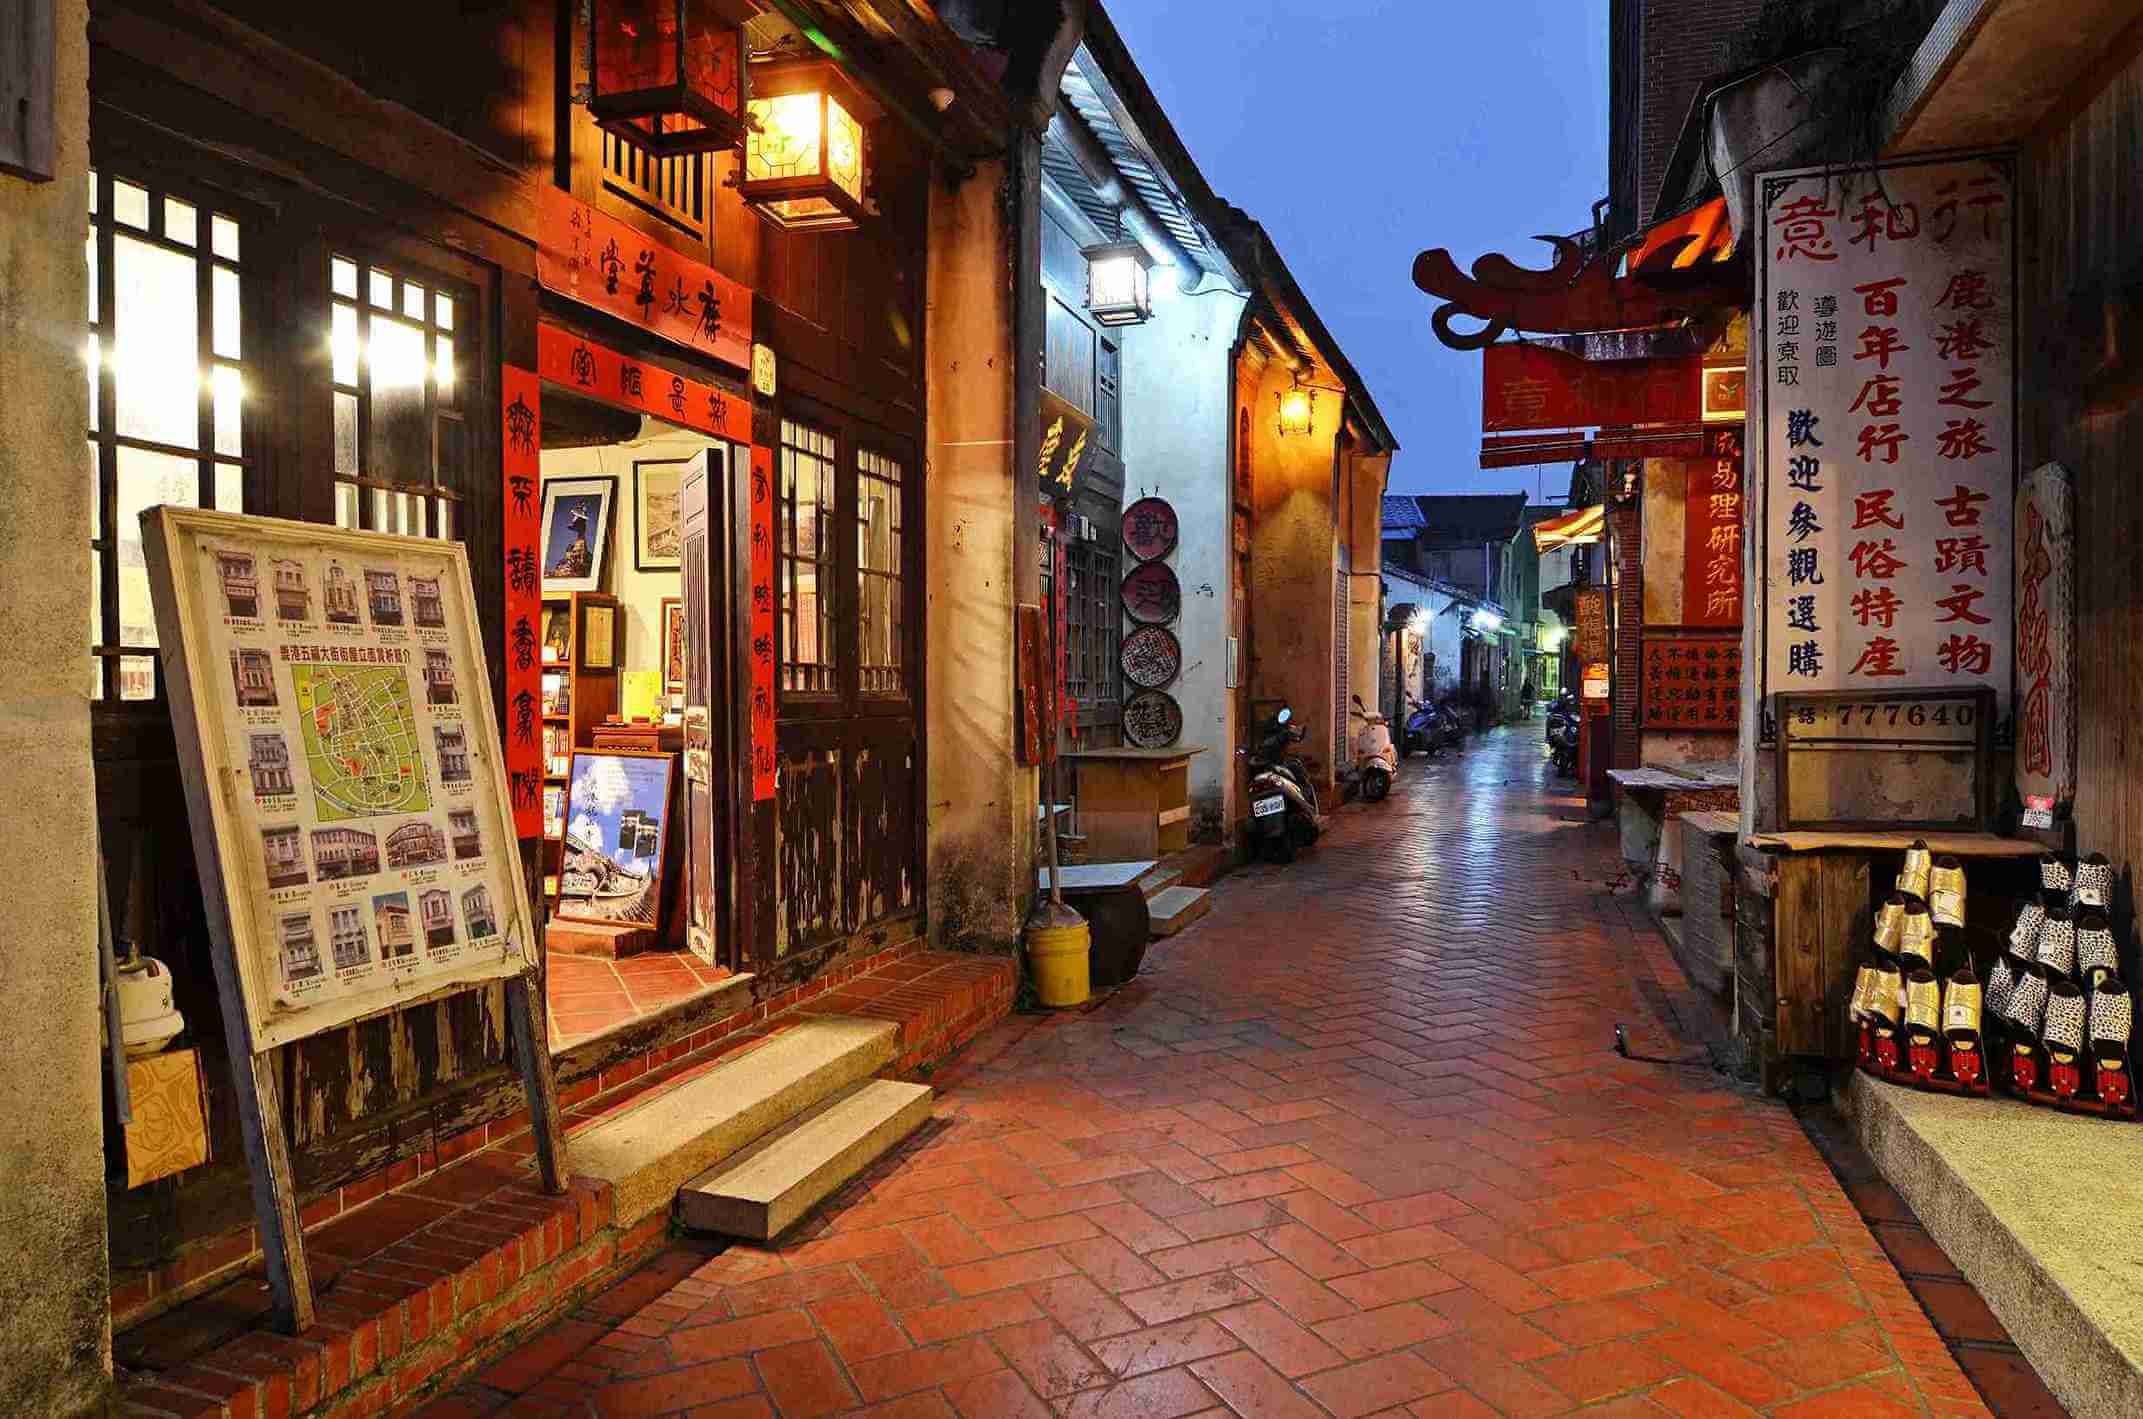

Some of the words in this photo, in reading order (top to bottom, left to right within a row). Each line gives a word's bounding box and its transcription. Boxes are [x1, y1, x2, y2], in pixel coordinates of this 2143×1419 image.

[1813, 295, 1838, 368] 導遊圖
[1848, 277, 1910, 465] 百年店行
[1785, 408, 1824, 677] 歡迎參觀選購
[1848, 488, 1908, 678] 民俗特產
[1934, 485, 1992, 675] 古蹟文物
[1837, 703, 1973, 726] 777640
